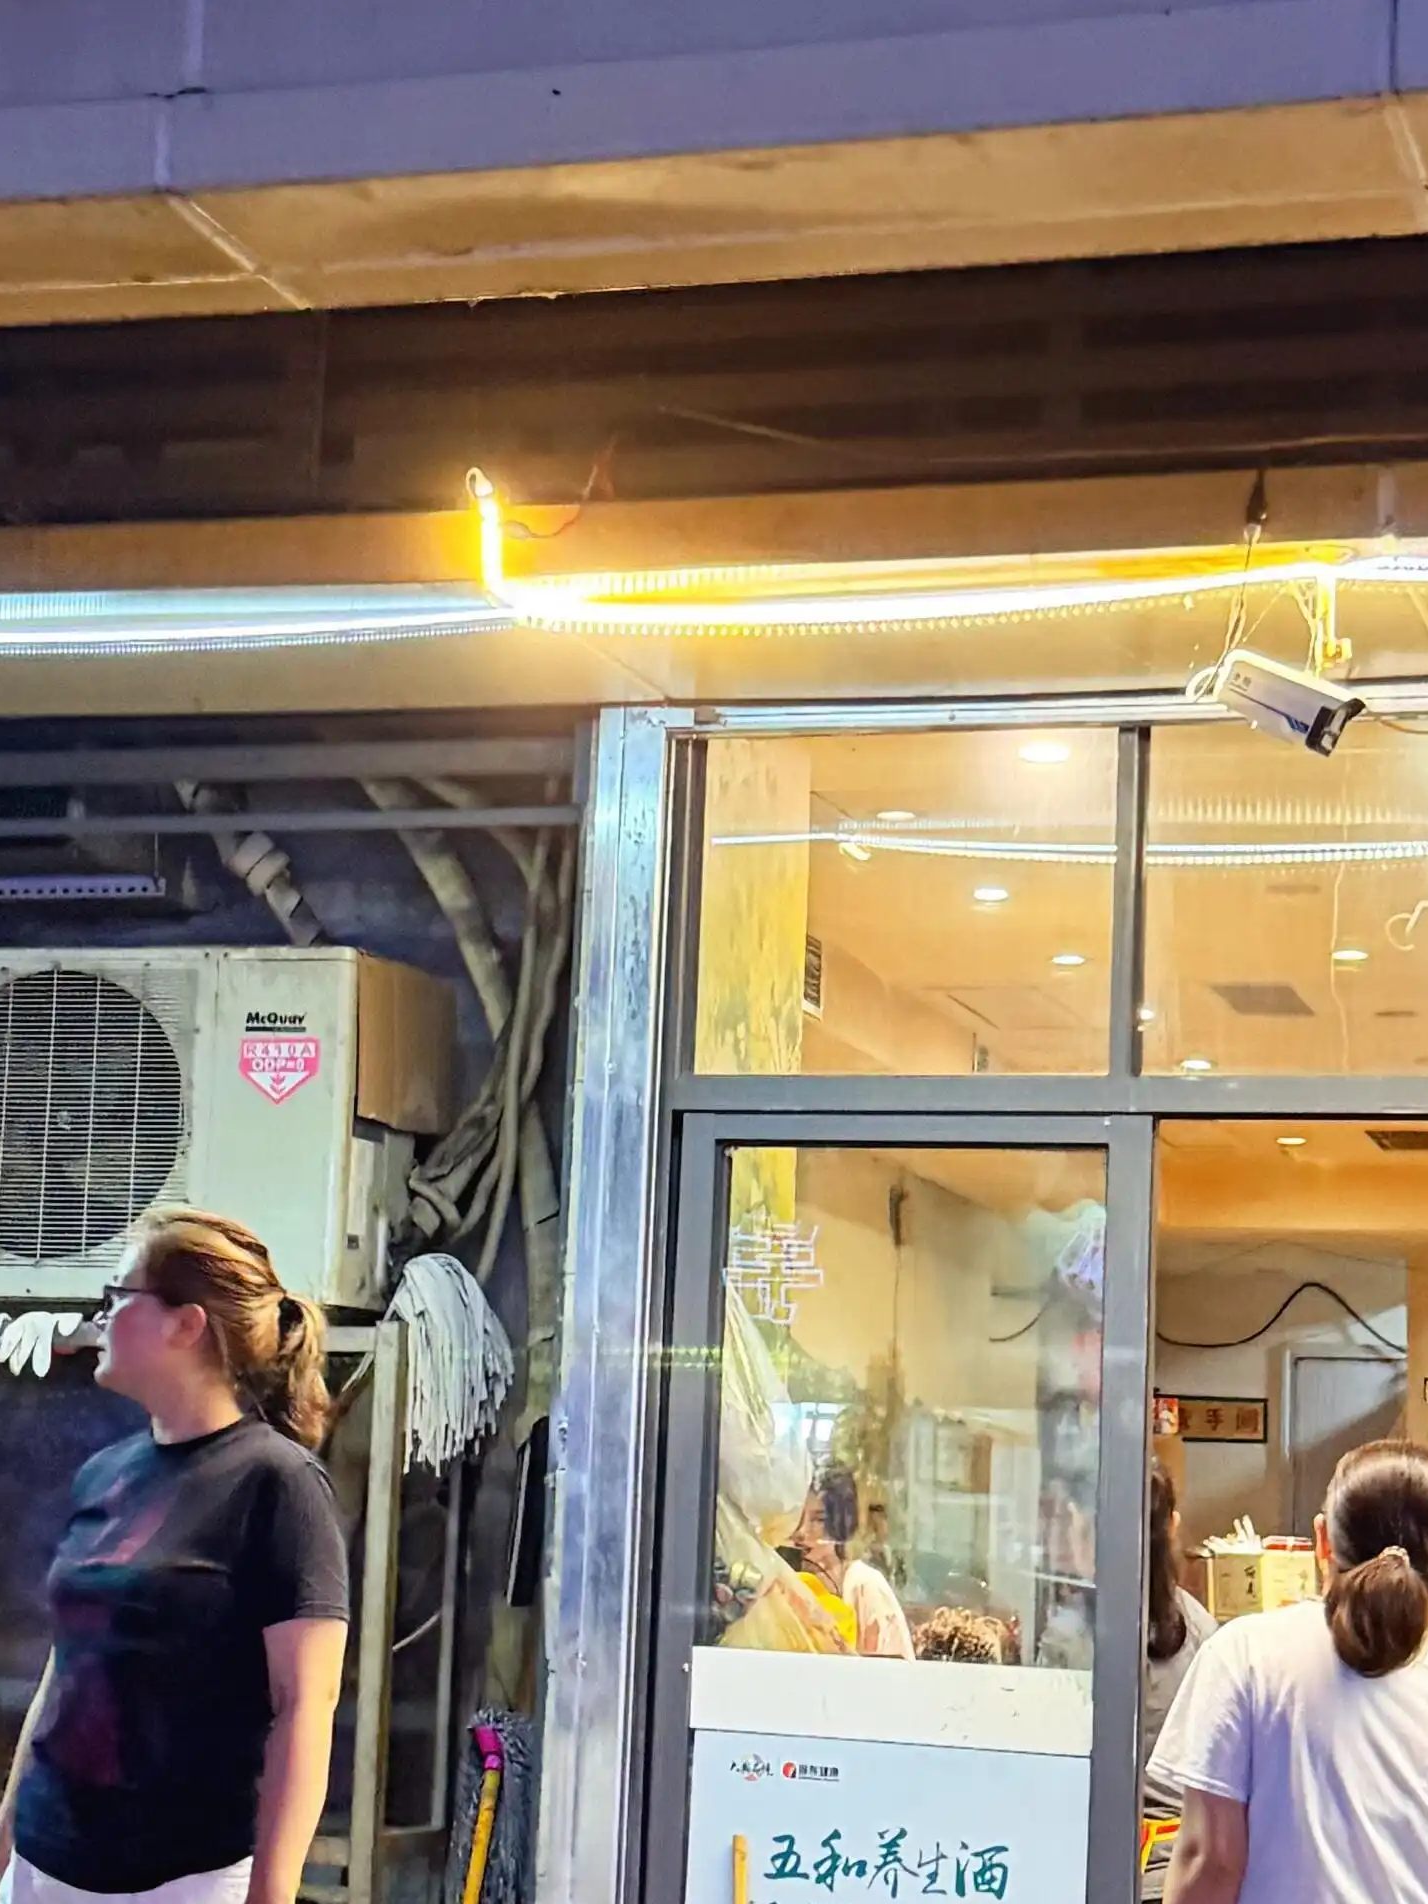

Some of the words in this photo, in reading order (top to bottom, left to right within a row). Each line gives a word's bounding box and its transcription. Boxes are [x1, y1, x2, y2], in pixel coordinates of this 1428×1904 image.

[763, 1827, 1010, 1901] 五和养生酒
